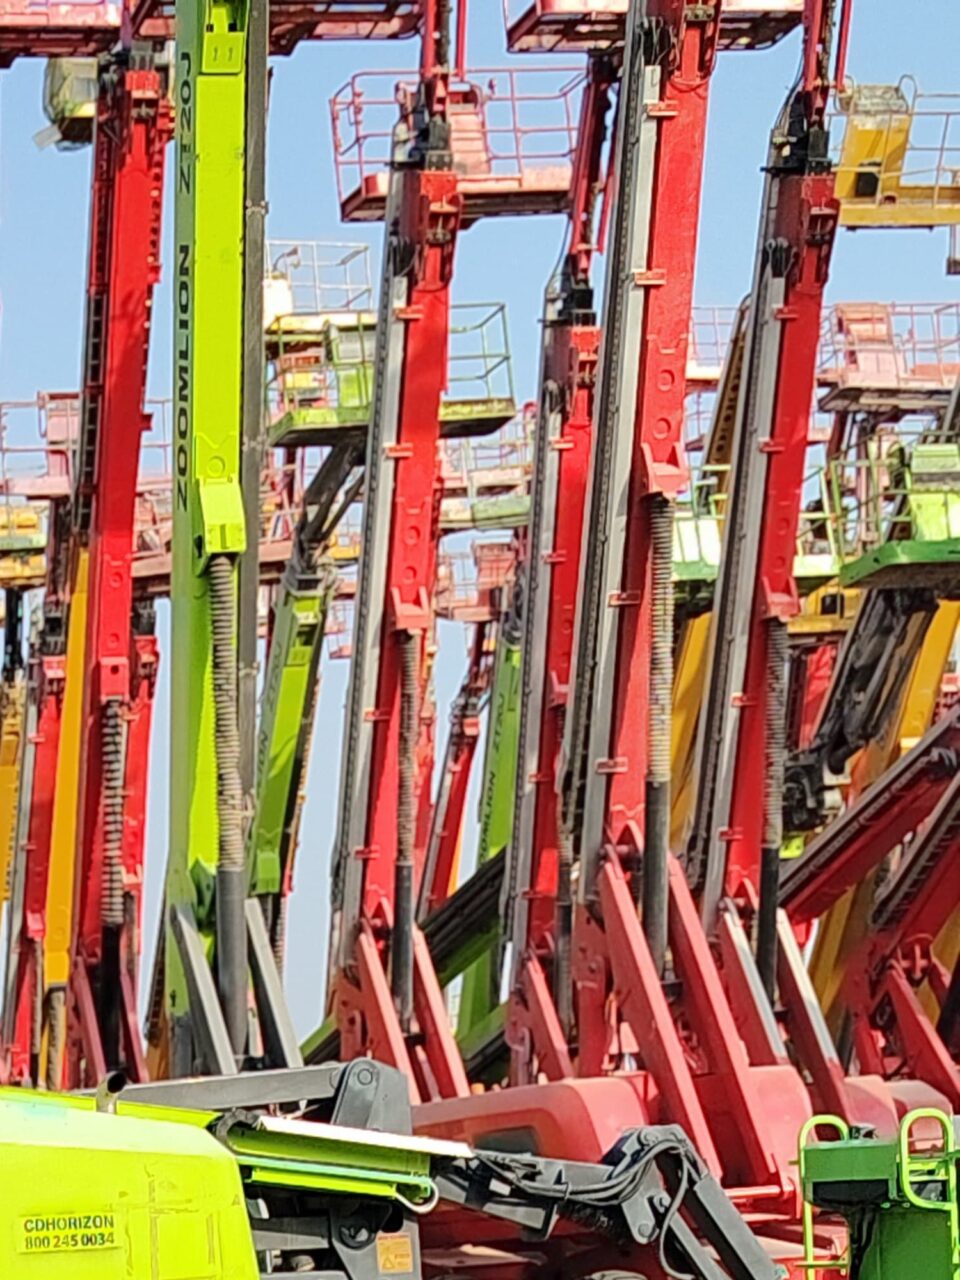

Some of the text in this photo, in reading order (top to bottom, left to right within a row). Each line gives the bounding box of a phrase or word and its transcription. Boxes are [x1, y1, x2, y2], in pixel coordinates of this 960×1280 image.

[176, 244, 190, 512] ZOOMLION
[23, 1215, 115, 1233] CDHORIZON
[25, 1232, 115, 1250] 800 245 0034
